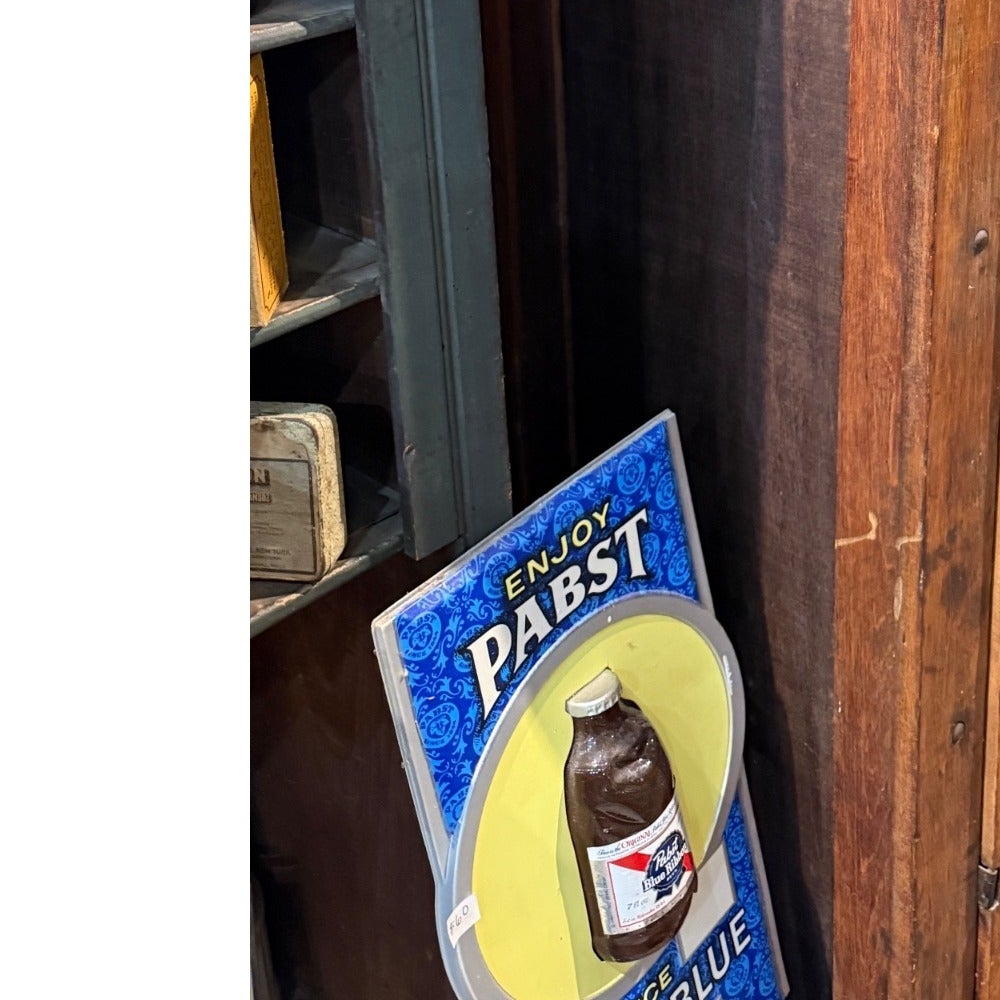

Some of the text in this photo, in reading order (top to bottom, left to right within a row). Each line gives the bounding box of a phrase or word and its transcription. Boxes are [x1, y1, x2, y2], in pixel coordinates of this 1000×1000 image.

[505, 502, 610, 600] ENJOY
[401, 613, 437, 640] PABST
[467, 508, 648, 720] PABST
[653, 836, 678, 871] Pabst
[643, 872, 666, 891] Blue
